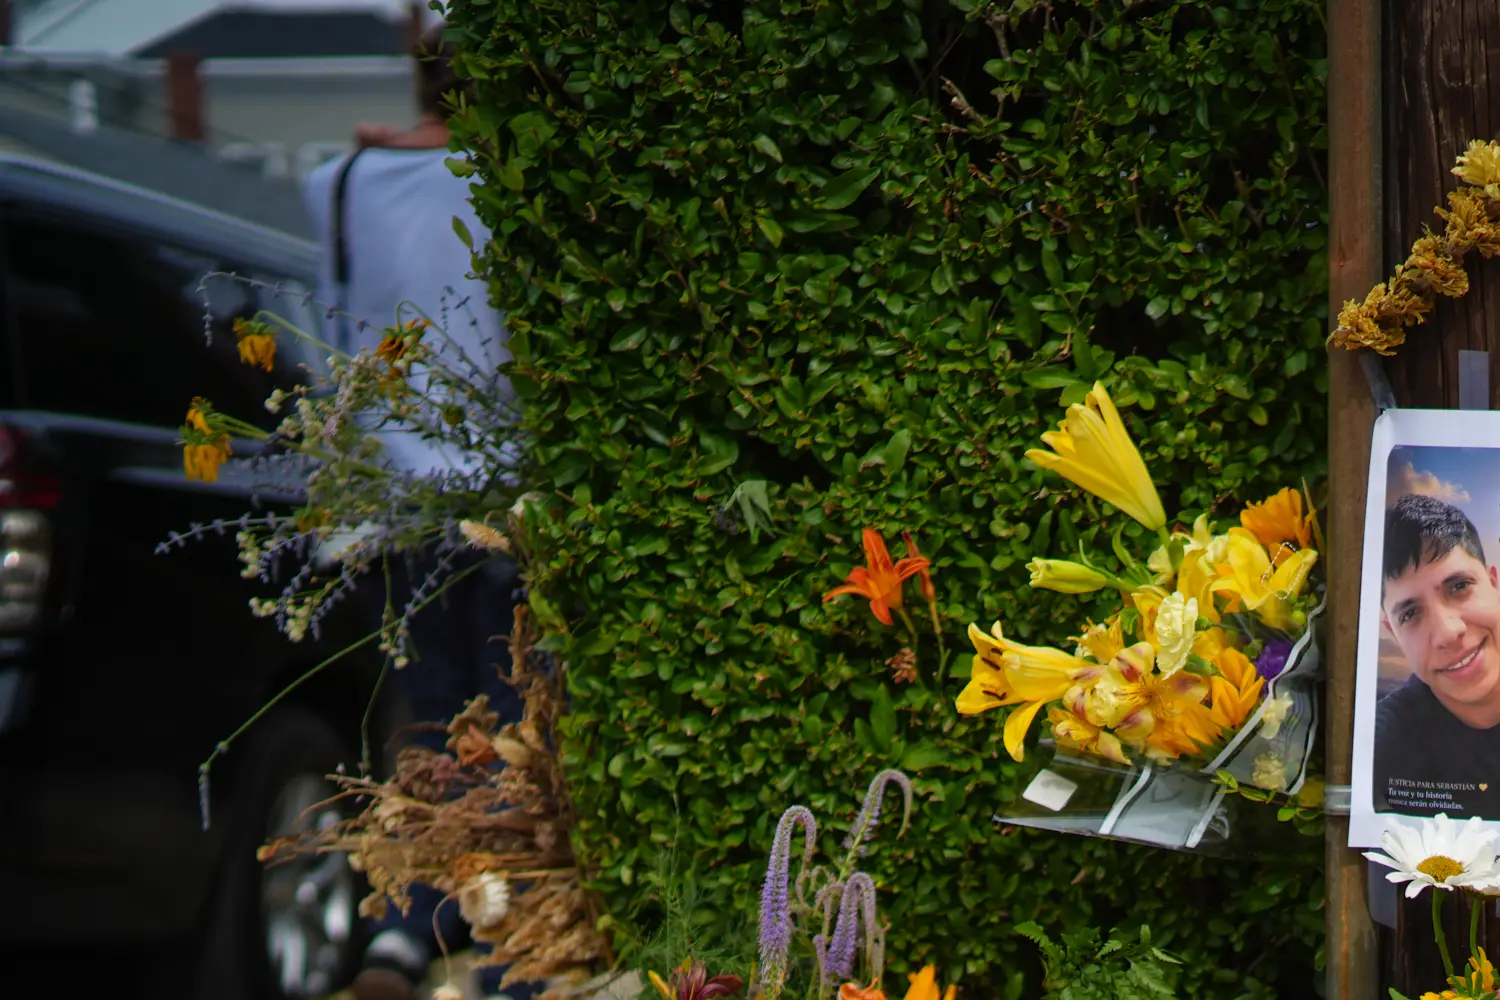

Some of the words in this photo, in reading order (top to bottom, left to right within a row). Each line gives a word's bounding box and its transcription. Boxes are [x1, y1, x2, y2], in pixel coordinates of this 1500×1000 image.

[1388, 777, 1416, 788] JUSTICIA
[1416, 780, 1436, 789] PARA
[1388, 787, 1397, 796] Tu
[1397, 789, 1410, 797] voz
[1416, 790, 1425, 798] tu
[1425, 791, 1453, 800] historia
[1388, 798, 1408, 806] nunca
[1428, 800, 1464, 810] olvidadas.
